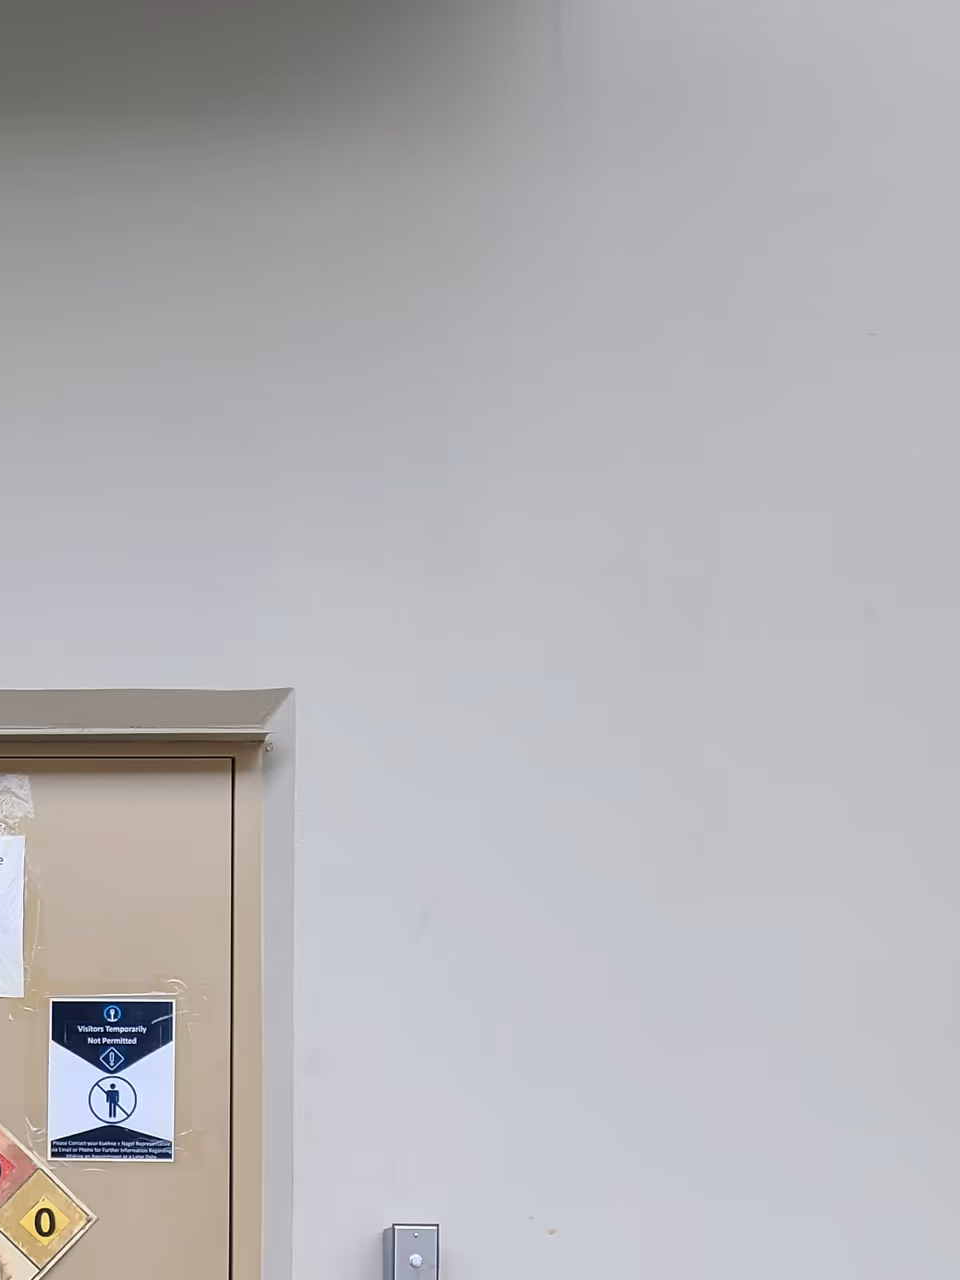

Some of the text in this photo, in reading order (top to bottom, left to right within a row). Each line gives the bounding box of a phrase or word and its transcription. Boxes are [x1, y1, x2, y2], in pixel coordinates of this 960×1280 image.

[77, 1025, 147, 1035] Visitors Temporarily
[87, 1037, 137, 1045] Not Permitted
[34, 1207, 56, 1238] 0
